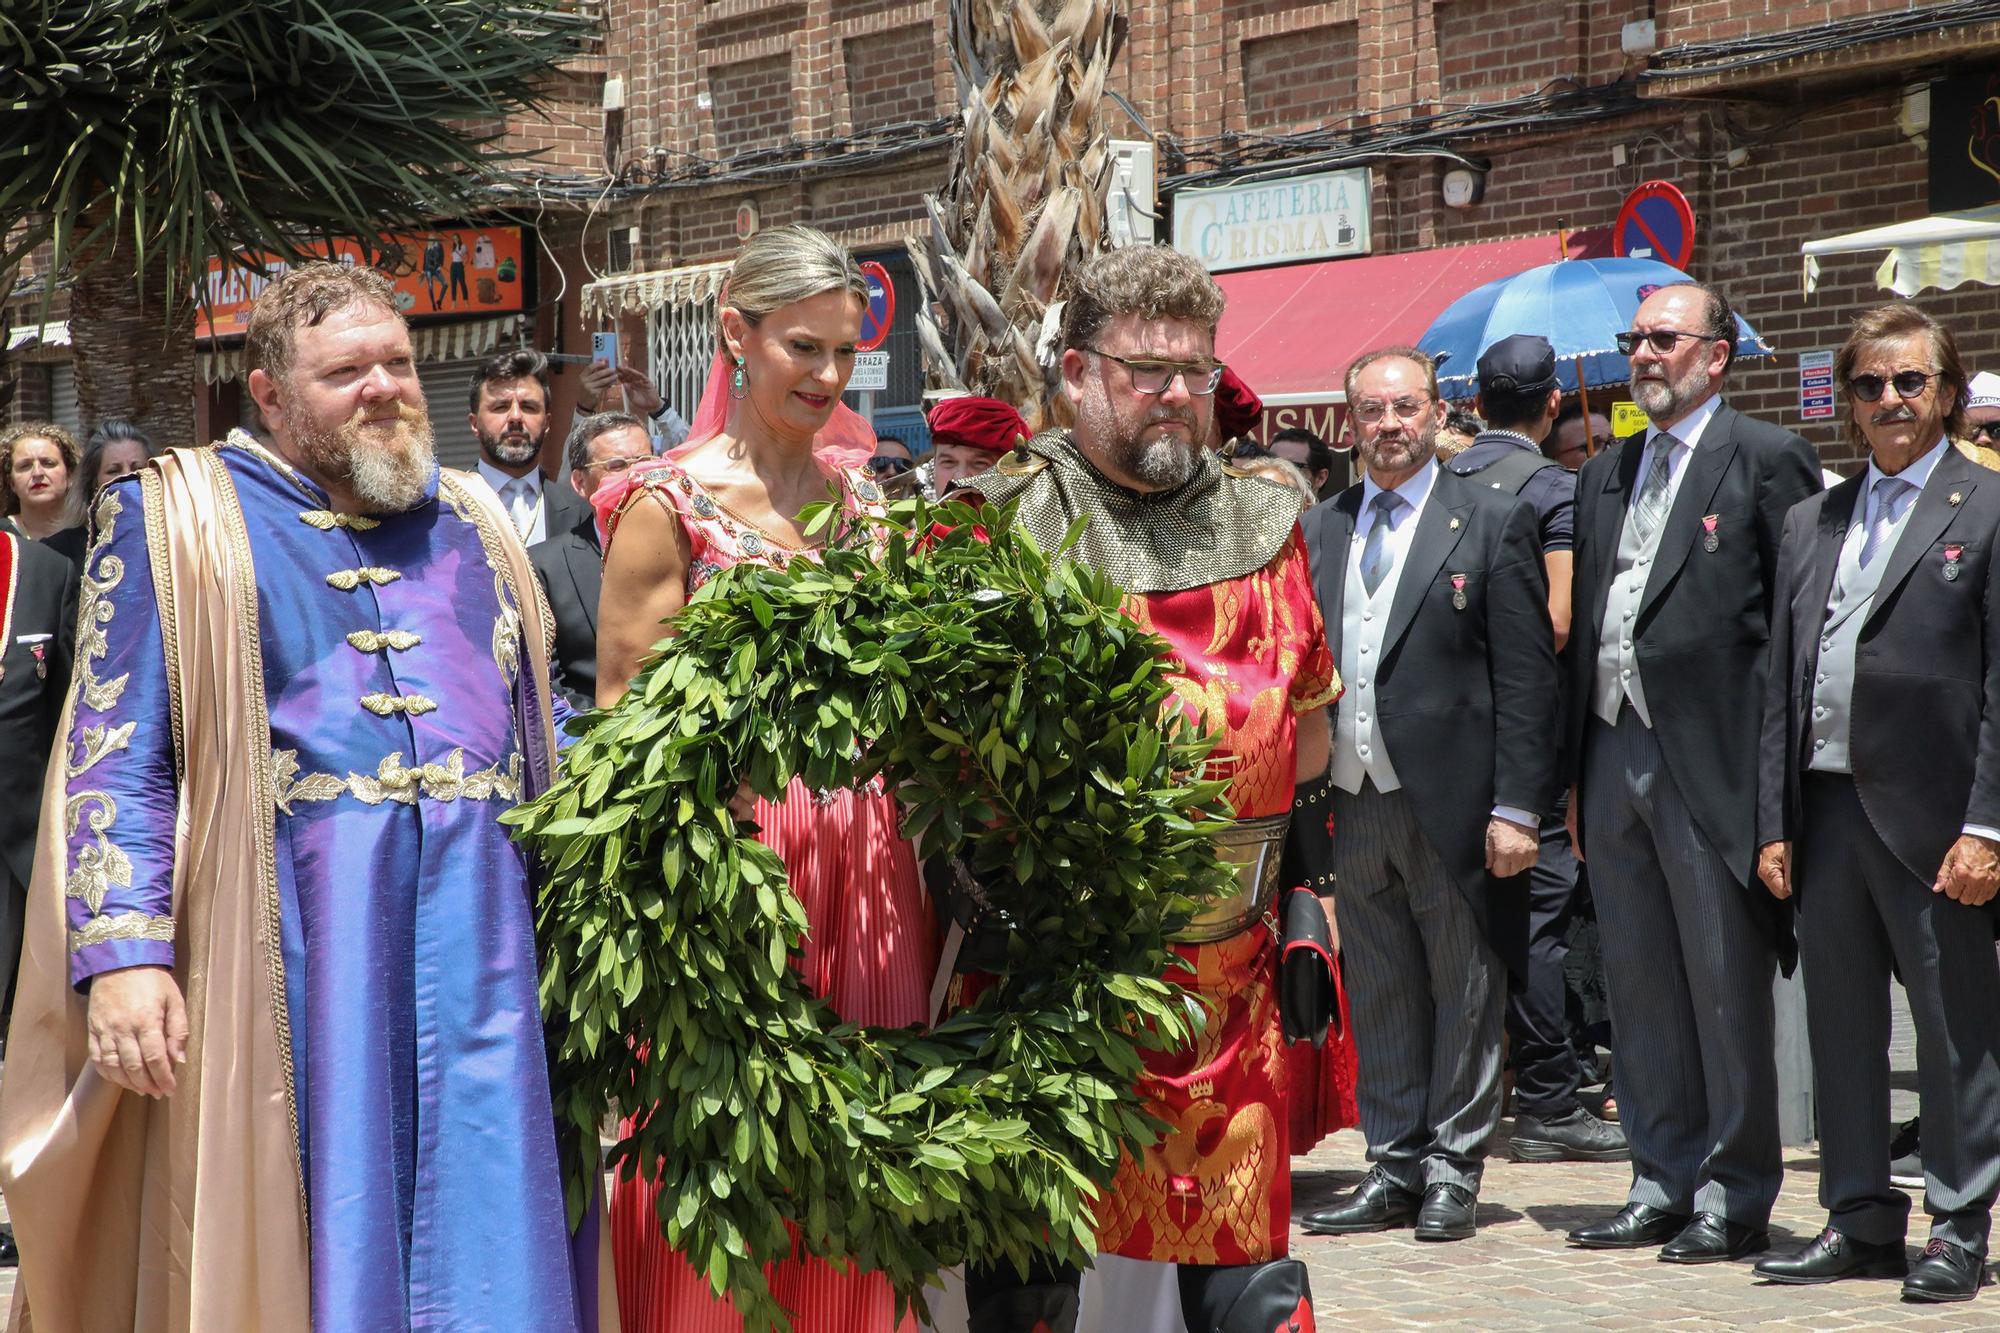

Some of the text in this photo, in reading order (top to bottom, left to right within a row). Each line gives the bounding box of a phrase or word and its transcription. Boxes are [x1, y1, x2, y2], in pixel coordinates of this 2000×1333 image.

[1181, 178, 1350, 262] CAFETERIA
[1201, 216, 1330, 262] CRISMA
[855, 356, 883, 366] ERRAZA
[1248, 407, 1350, 446] ISMA
